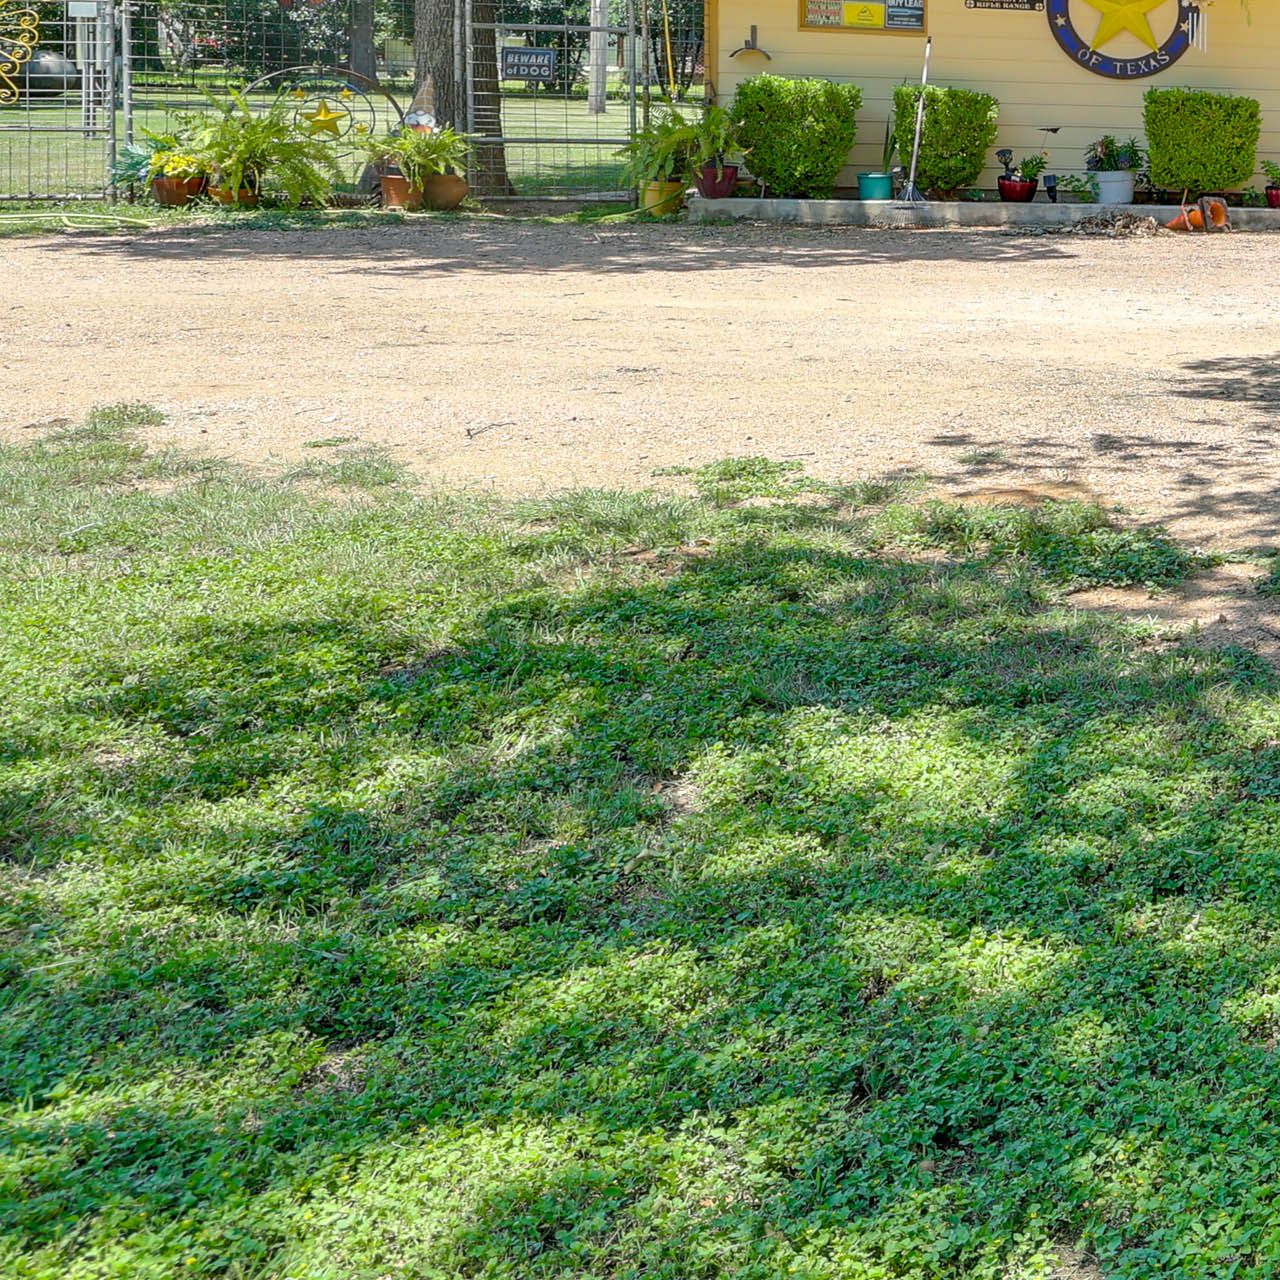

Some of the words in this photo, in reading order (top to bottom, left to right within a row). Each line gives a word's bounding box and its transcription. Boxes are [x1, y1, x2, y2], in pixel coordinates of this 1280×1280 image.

[888, 0, 904, 7] BUY
[507, 53, 550, 64] BEWARE
[1078, 48, 1102, 67] OF
[1112, 50, 1170, 75] TEXAS
[507, 66, 518, 75] of
[520, 66, 550, 76] DOG
